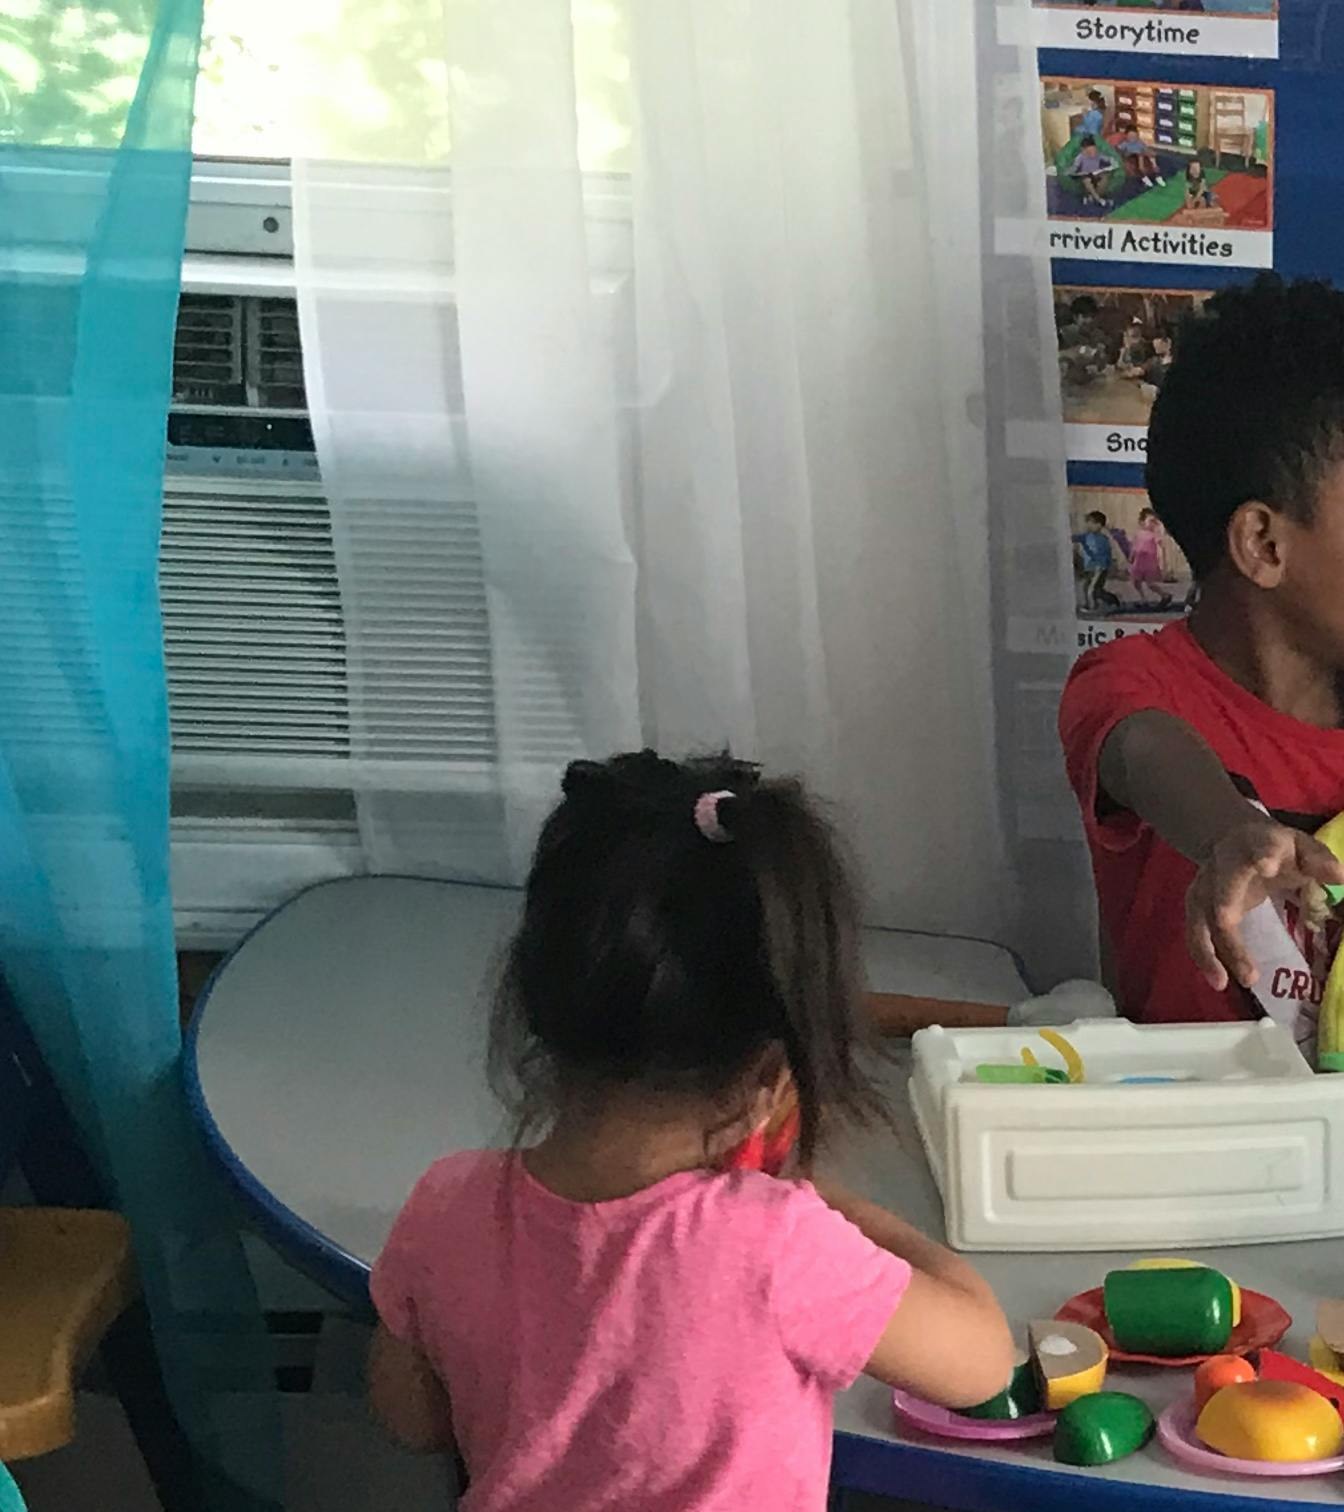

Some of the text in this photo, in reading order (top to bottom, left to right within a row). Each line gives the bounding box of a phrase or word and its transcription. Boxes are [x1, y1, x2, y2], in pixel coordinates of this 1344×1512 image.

[1075, 16, 1200, 47] Storytime
[1049, 226, 1233, 258] rrival Activities
[1106, 432, 1149, 453] Sna
